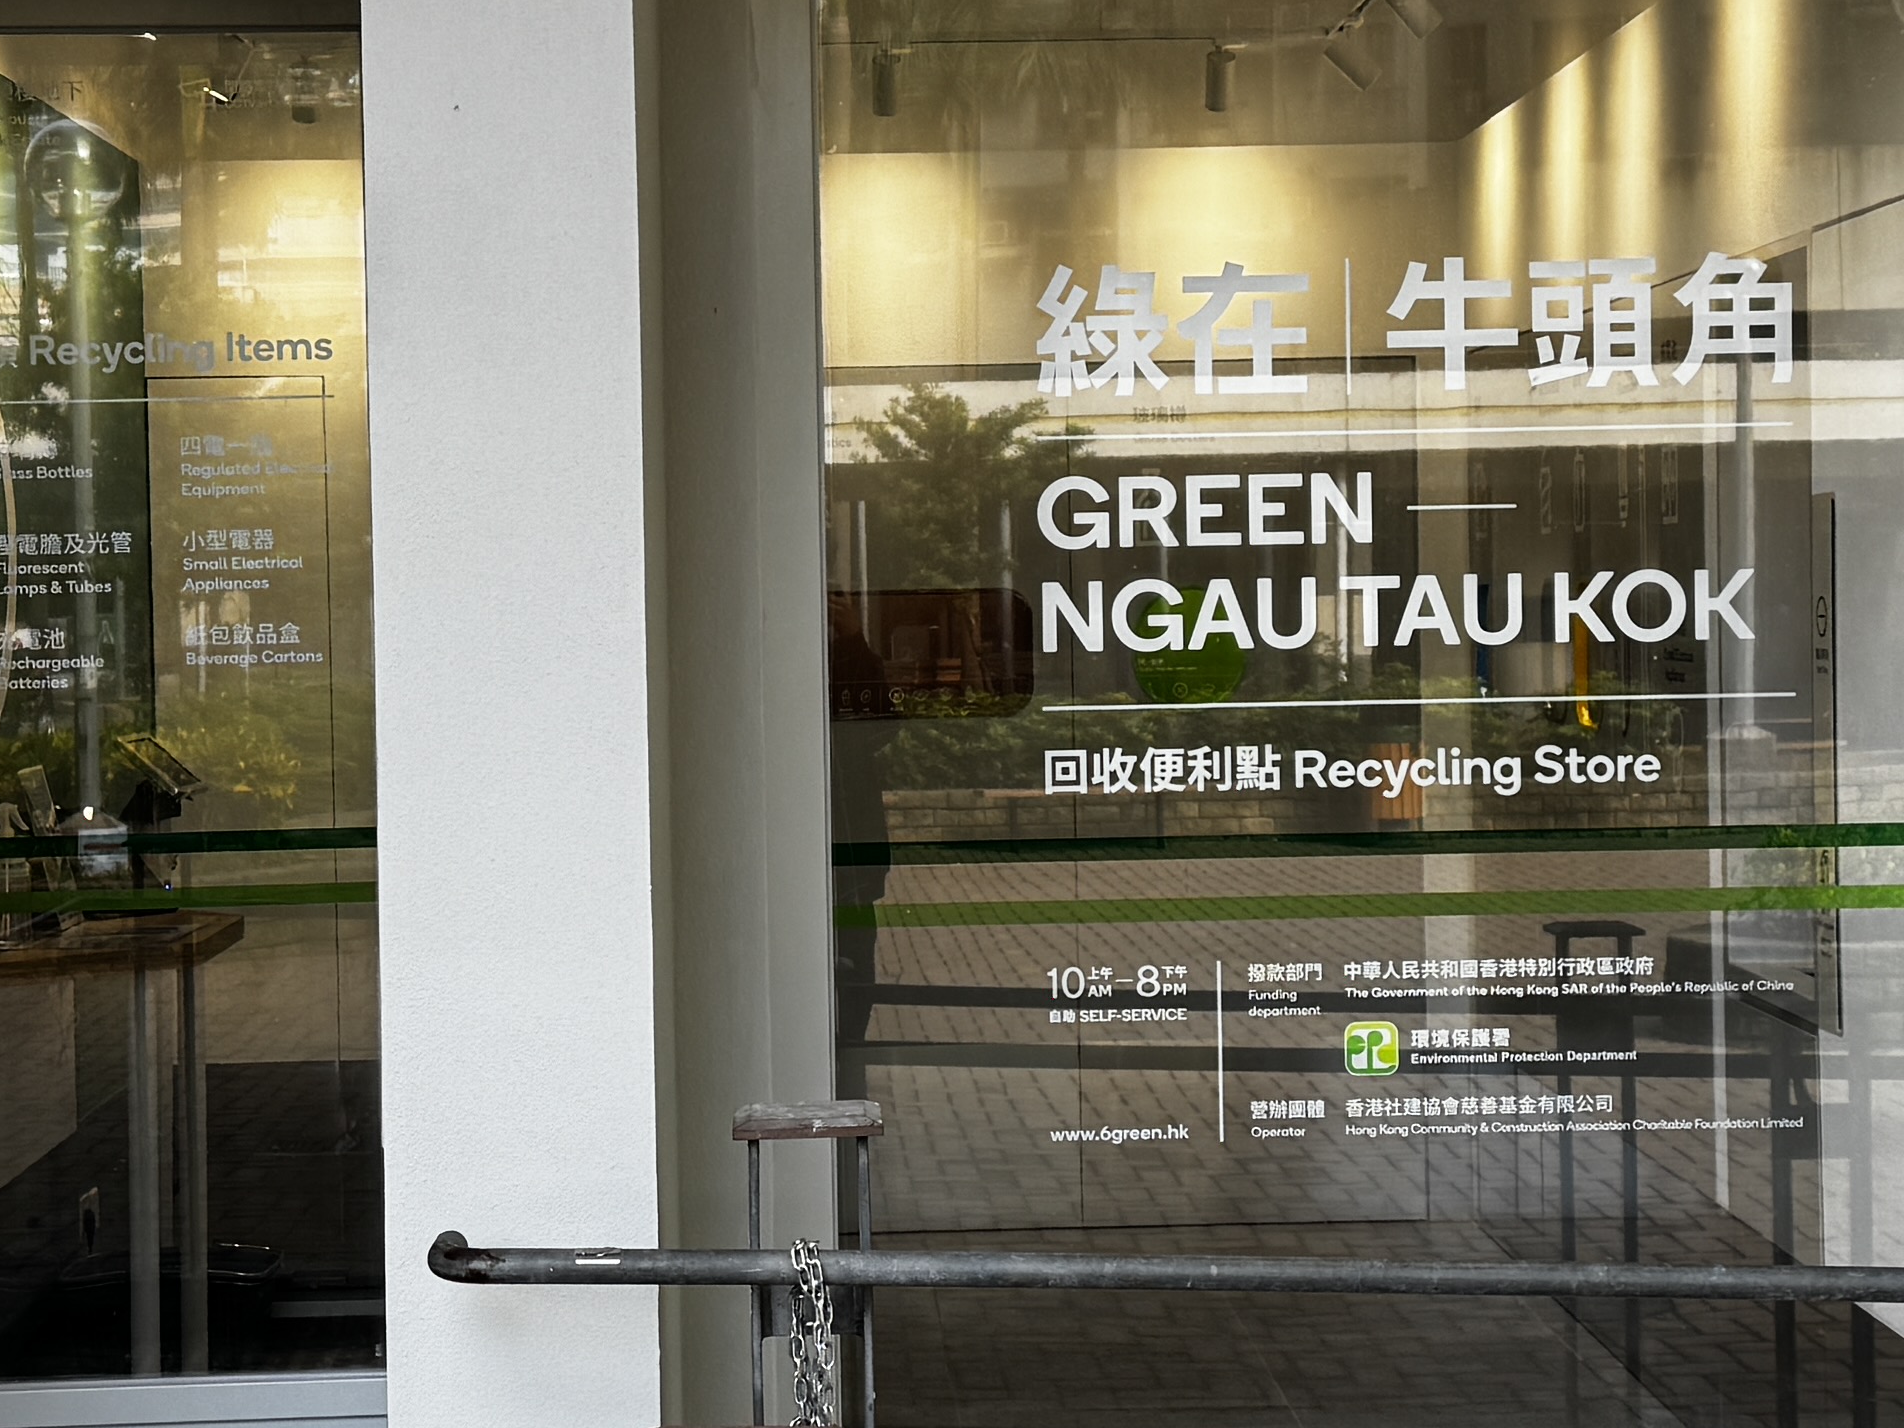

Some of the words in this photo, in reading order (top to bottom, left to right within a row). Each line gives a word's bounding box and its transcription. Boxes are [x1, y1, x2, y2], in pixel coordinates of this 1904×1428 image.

[1034, 260, 1311, 398] 綠在
[1385, 251, 1795, 392] 牛頭角
[29, 333, 215, 373] Recycling
[225, 331, 334, 363] Items
[36, 464, 93, 479] Bottles
[181, 462, 260, 479] Regulated
[181, 483, 266, 499] Equipment
[1036, 471, 1374, 551] GREEN
[182, 529, 275, 552] 小型電器
[182, 556, 228, 571] Small
[232, 555, 304, 570] Electrical
[50, 581, 62, 594] &
[65, 580, 112, 594] Tubes
[182, 577, 270, 595] Appliances
[1041, 577, 1317, 654] NGAU
[1339, 572, 1523, 647] TAU
[1555, 568, 1756, 643] KOK
[185, 622, 301, 647] 紙包飲品盒
[186, 651, 258, 668] Beverage
[262, 650, 324, 665] Cartons
[1043, 745, 1281, 797] 回收便利點
[1294, 745, 1523, 797] Recycling
[1533, 742, 1662, 785] Store
[1343, 956, 1655, 981] 中華人民共和國香港特別行政區政府
[1046, 965, 1086, 1000] 10
[1087, 966, 1114, 981] 上午
[1136, 964, 1161, 998] 8
[1161, 964, 1188, 980] 下午
[1087, 984, 1113, 998] AM
[1162, 983, 1188, 997] PM
[1344, 987, 1369, 999] The
[1371, 985, 1448, 998] Government
[1451, 985, 1466, 997] of
[1467, 985, 1488, 997] the
[1490, 984, 1524, 999] Hong
[1526, 983, 1559, 998] Kong
[1561, 982, 1588, 995] SAR
[1590, 981, 1605, 994] of
[1605, 982, 1627, 994] the
[1629, 981, 1682, 996] People's
[1684, 980, 1739, 994] Republic
[1741, 979, 1754, 991] of
[1756, 979, 1795, 992] China
[1247, 989, 1298, 1002] Funding
[1079, 1007, 1188, 1023] SELF-SERVICE
[1247, 1005, 1322, 1018] department
[1410, 1027, 1511, 1049] 環境保護署
[1410, 1051, 1498, 1065] Environmental
[1501, 1050, 1564, 1064] Protection
[1566, 1049, 1638, 1063] Department
[1250, 1099, 1326, 1120] 營辦團體
[1345, 1094, 1614, 1118] 香港社建協會慈善基金有限公司
[1049, 1123, 1189, 1145] www.6green.hk
[1250, 1125, 1306, 1139] Operator
[1345, 1123, 1378, 1138] Hong
[1379, 1123, 1409, 1138] Kong
[1410, 1122, 1479, 1137] Community
[1479, 1123, 1490, 1134] &
[1491, 1120, 1565, 1133] Construction
[1565, 1119, 1631, 1132] Association
[1632, 1118, 1693, 1131] Charitable
[1694, 1117, 1758, 1131] Foundation
[1760, 1116, 1804, 1130] Limited
